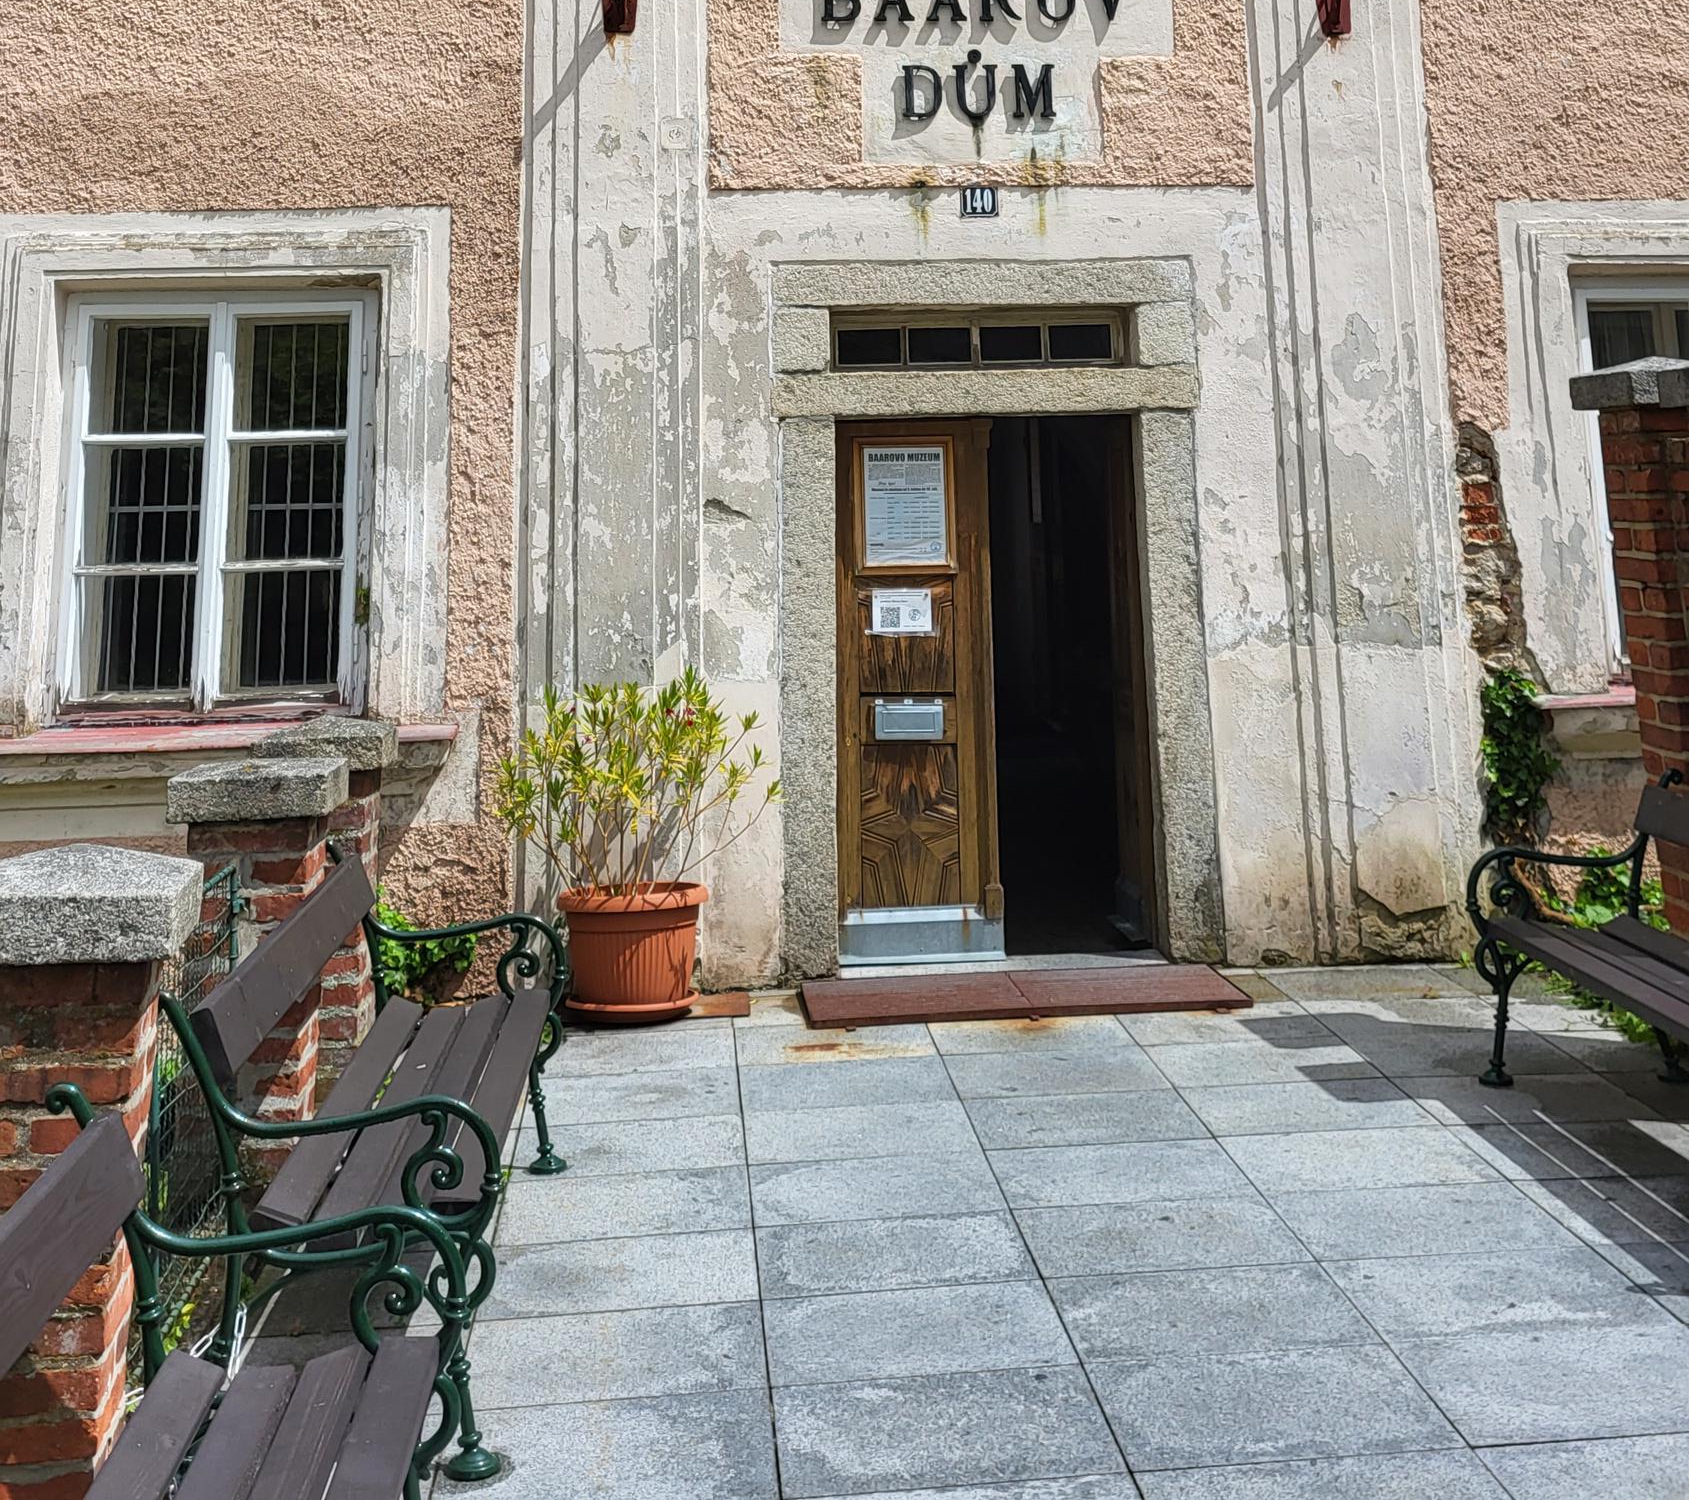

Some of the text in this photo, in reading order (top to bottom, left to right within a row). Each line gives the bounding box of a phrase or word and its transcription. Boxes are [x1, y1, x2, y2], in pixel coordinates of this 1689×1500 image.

[902, 49, 1057, 120] DŮM
[964, 189, 993, 214] 140
[868, 453, 940, 462] BAAROVO MUZEUM
